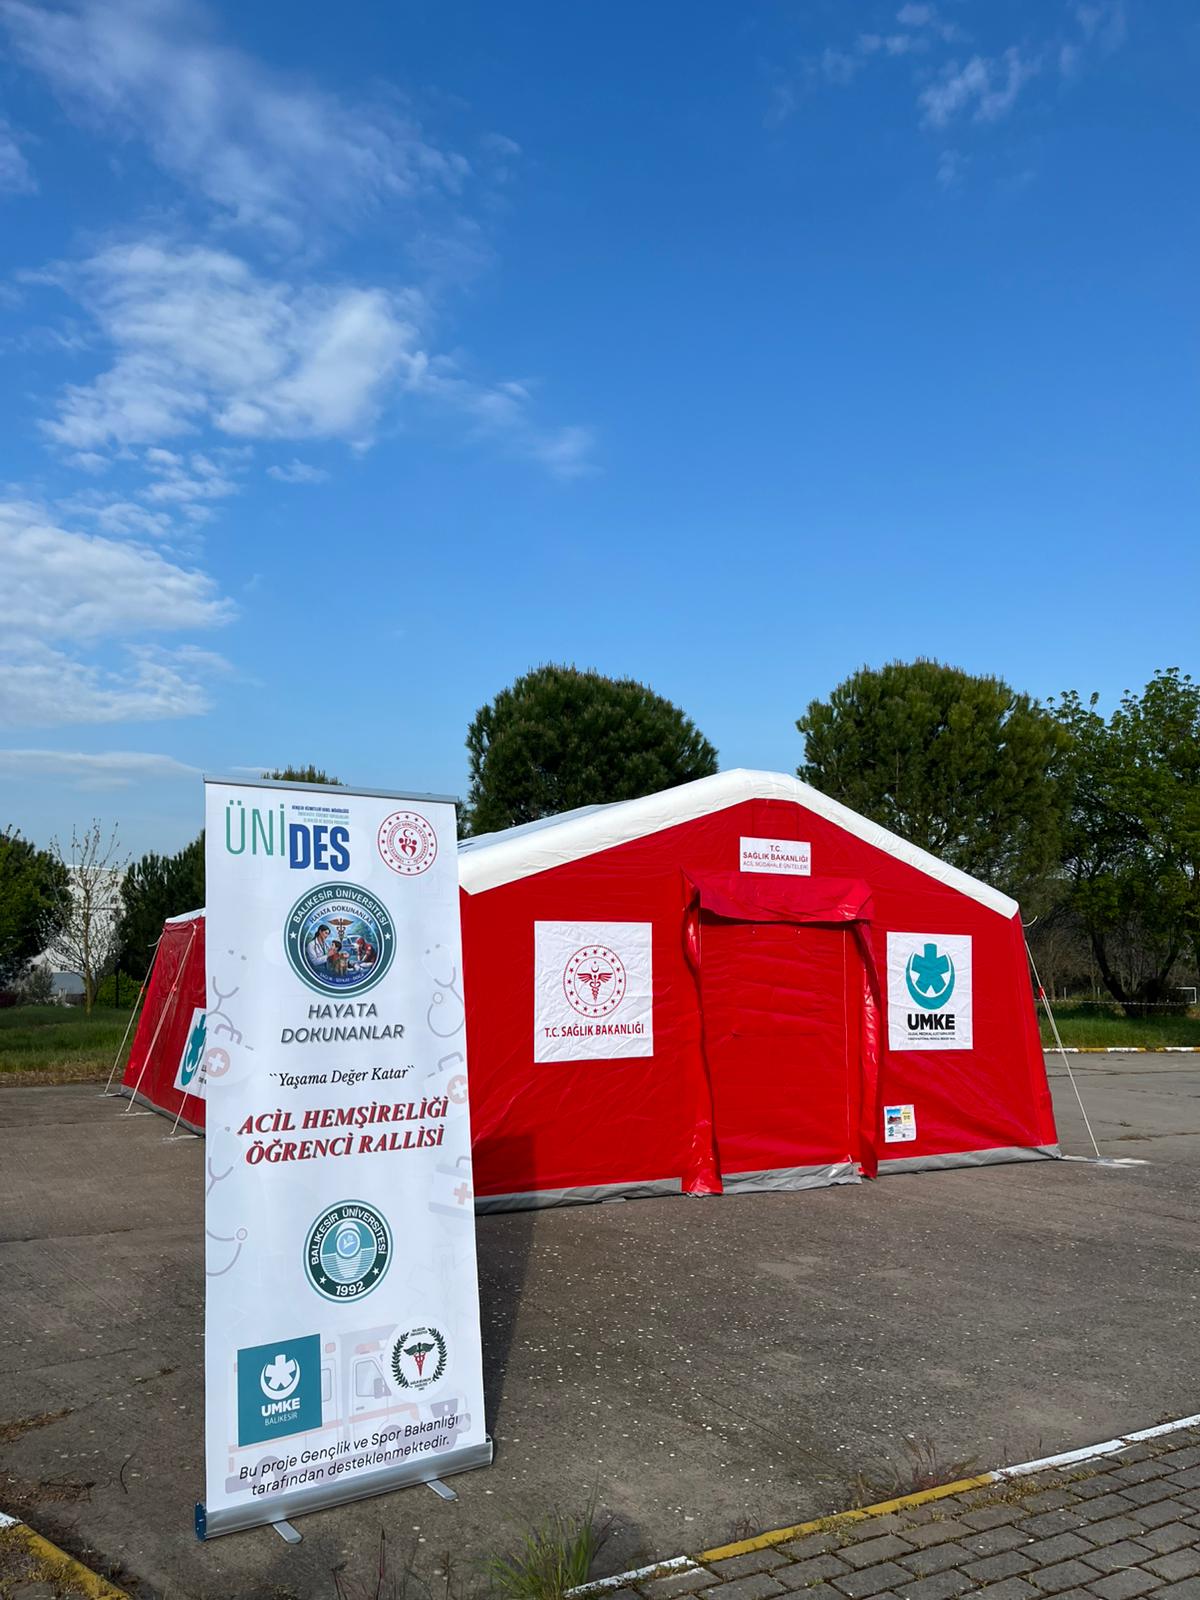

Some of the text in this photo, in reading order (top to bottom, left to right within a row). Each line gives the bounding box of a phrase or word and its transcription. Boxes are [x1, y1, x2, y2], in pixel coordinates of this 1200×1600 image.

[743, 851, 808, 862] SAĞLIK BAKANLIĞI
[292, 887, 389, 926] BALIKESİR ÜNİVERSİTESİ
[310, 905, 373, 925] HAYATA DOKUNANLAR
[308, 1002, 378, 1019] HAYATA
[544, 1021, 644, 1038] T.C. SAĞLIK BAKANLIĞI
[907, 1013, 956, 1031] UMKE
[280, 1024, 405, 1043] DOKUNANLAR
[331, 1069, 368, 1086] Değer
[237, 1095, 450, 1136] ACİL HEMŞİRELİĞİ
[245, 1124, 445, 1165] ÖĞRENCİ RALLİSİ
[311, 1206, 387, 1265] BALIKESİR ÜNİVERSİTESİ
[335, 1280, 366, 1296] 1992
[261, 1397, 301, 1417] UMKE
[239, 1413, 459, 1480] Bu proje Gençlik ve Spor Bakanlığı
[251, 1434, 450, 1496] tarafından desteklenmektedir.
